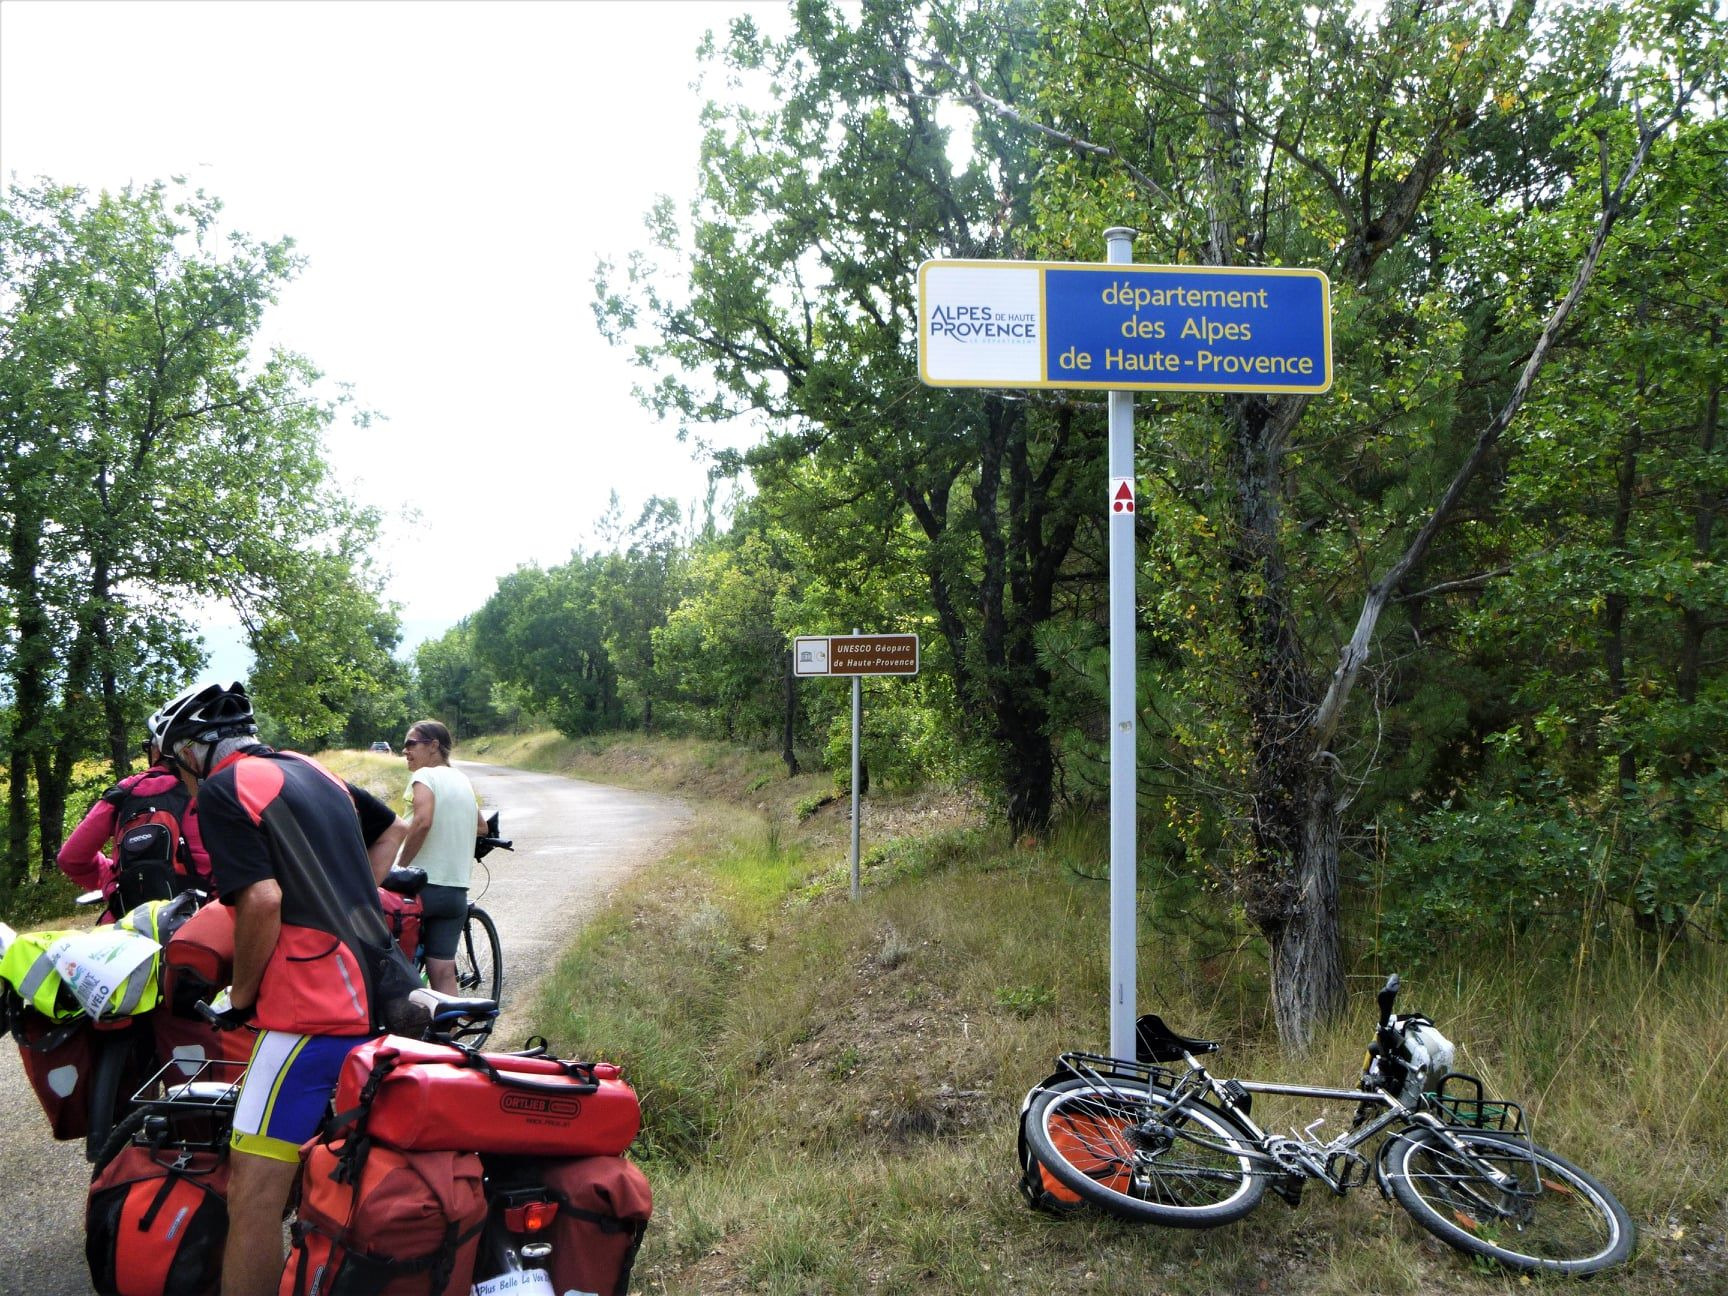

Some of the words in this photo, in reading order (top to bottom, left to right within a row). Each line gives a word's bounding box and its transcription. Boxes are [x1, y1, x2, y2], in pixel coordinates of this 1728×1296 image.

[1101, 281, 1268, 311] département
[931, 305, 992, 321] ALPES
[995, 313, 1006, 321] DE
[1008, 314, 1036, 322] HAUTE
[930, 321, 1036, 343] PROVENCE
[1121, 314, 1165, 339] des
[1180, 316, 1251, 345] Alpes
[1059, 346, 1092, 370] de
[1105, 348, 1313, 374] Haute-Provence
[837, 644, 872, 653] UNESCO
[875, 644, 911, 654] Géoparc
[833, 658, 843, 667] de
[847, 657, 914, 667] Haute-Provence
[499, 1276, 518, 1290] Belle
